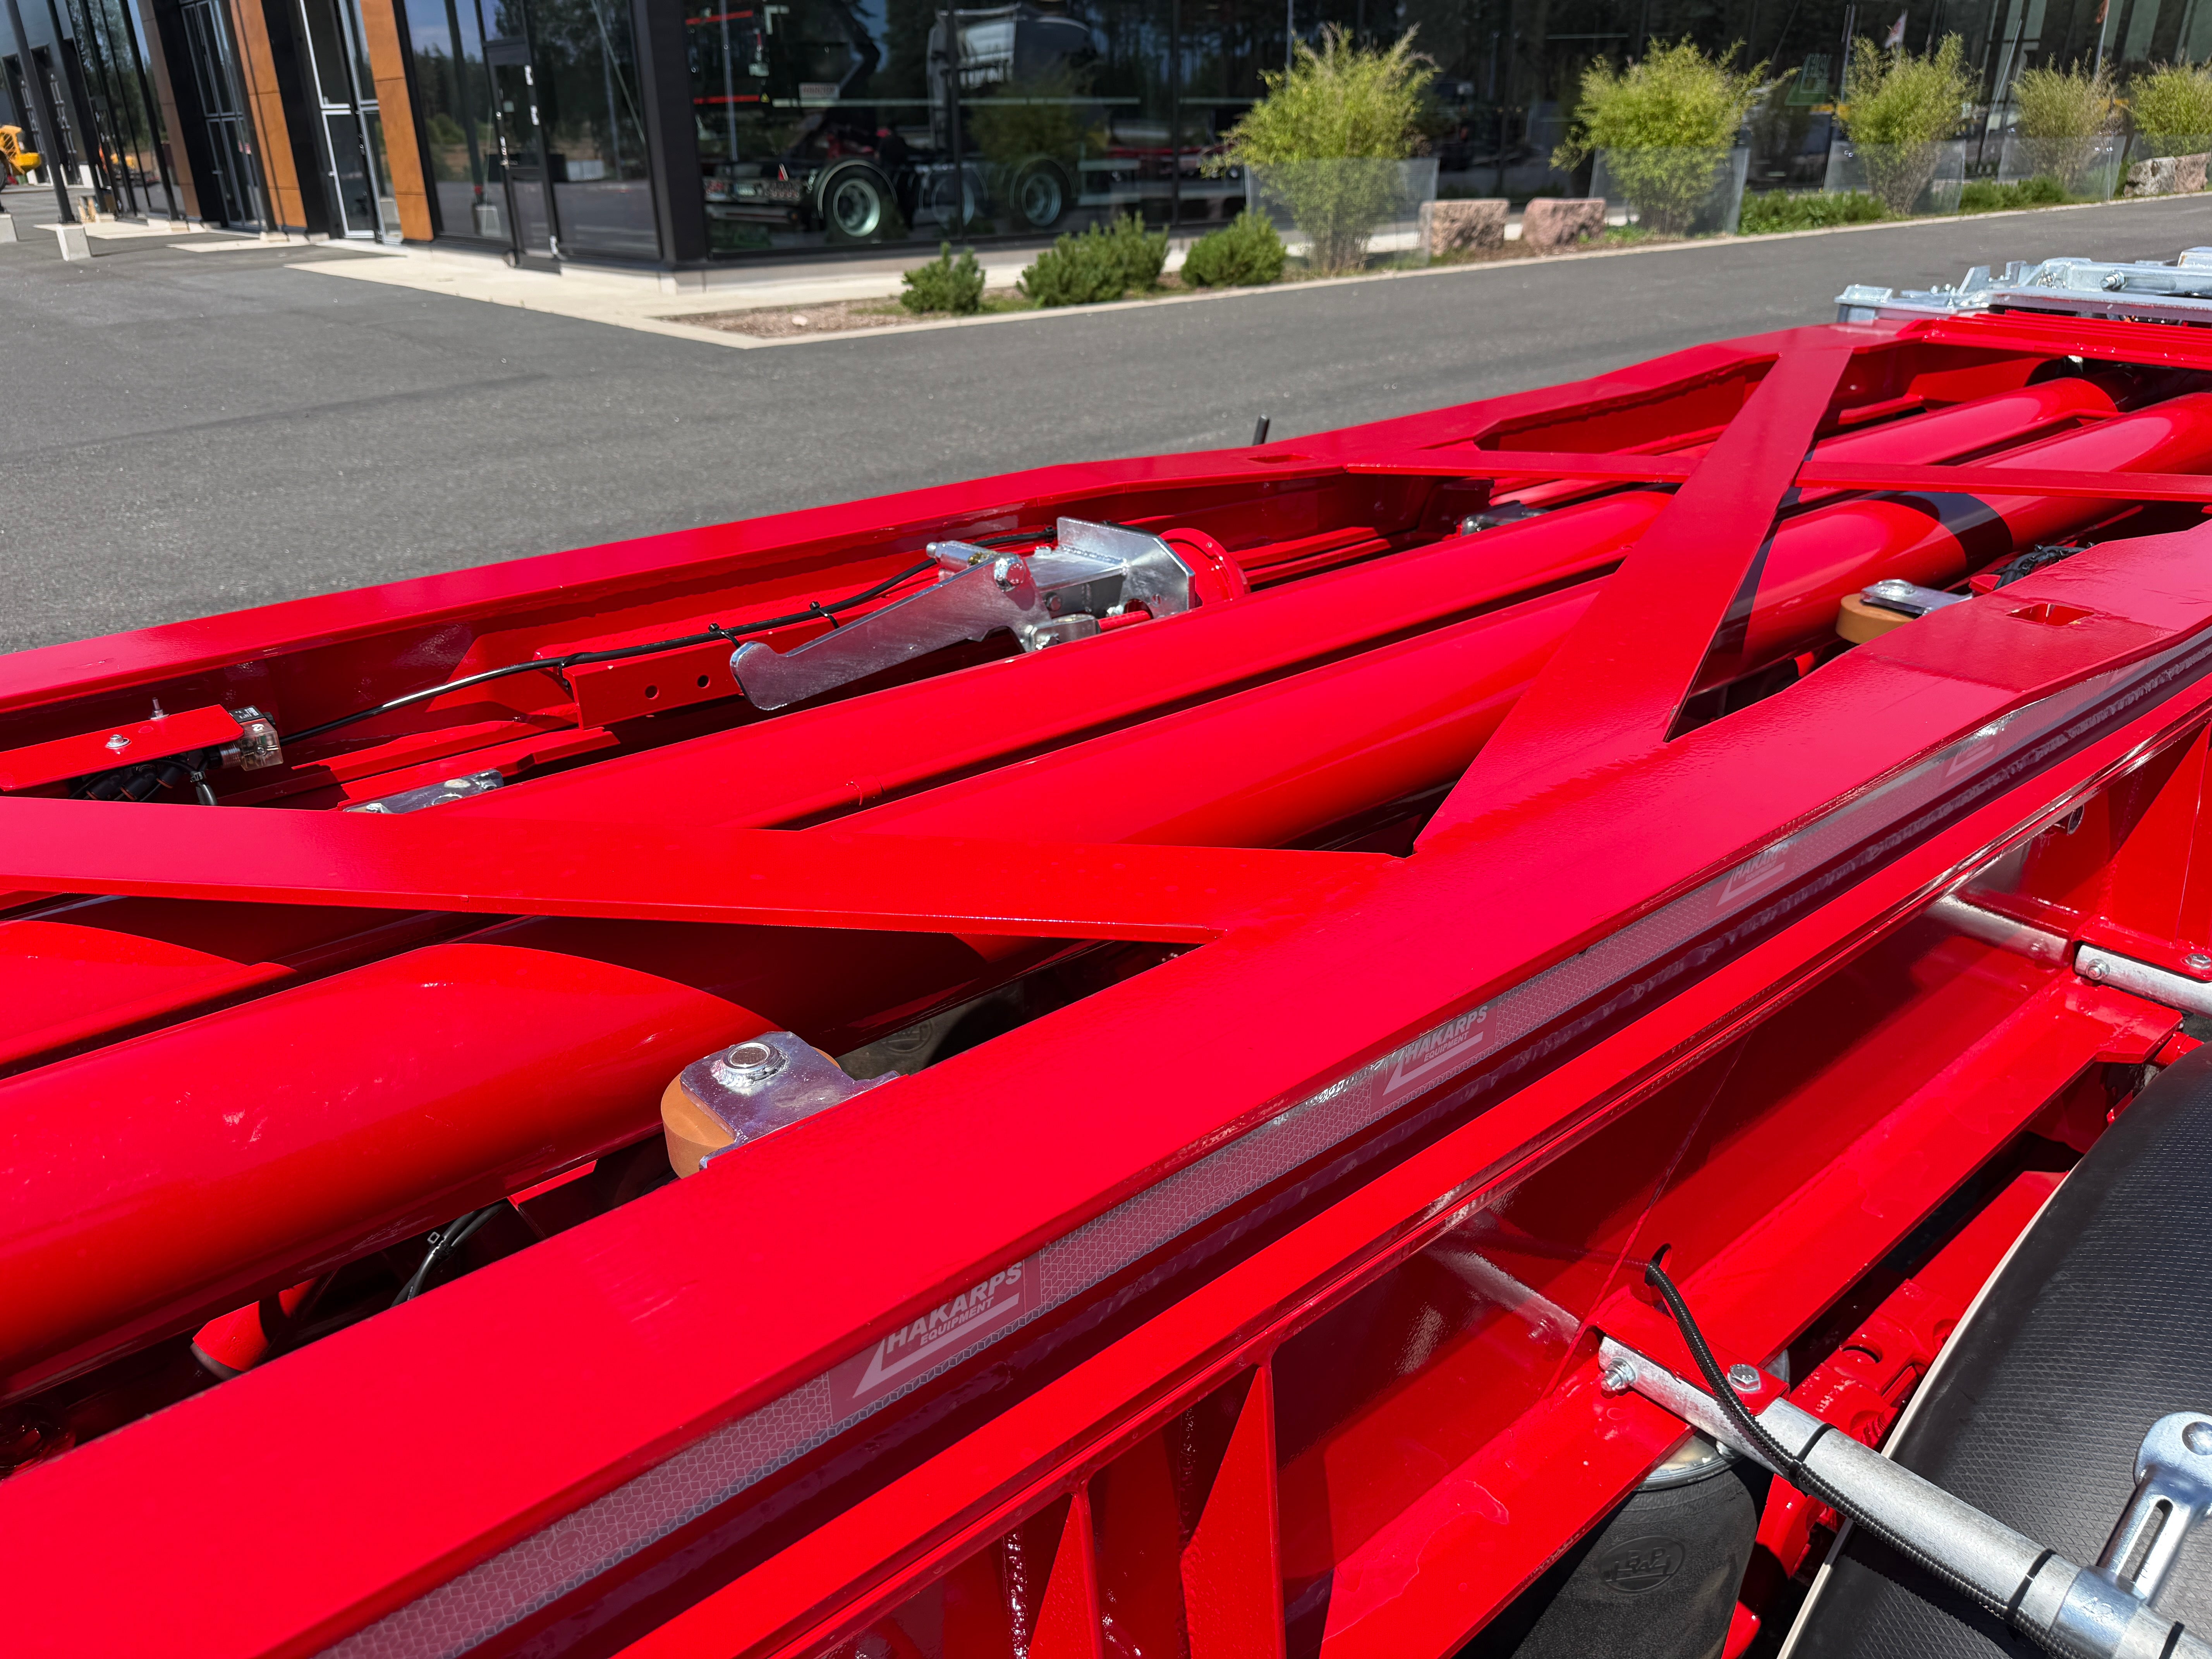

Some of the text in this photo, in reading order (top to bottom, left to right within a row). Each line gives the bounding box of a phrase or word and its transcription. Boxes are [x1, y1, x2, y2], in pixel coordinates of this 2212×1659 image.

[1405, 1005, 1488, 1064] HAKARPS
[1424, 1031, 1469, 1062] EQUIPMENT
[1214, 1169, 1227, 1183] E4
[1192, 1198, 1206, 1212] 104
[886, 1261, 1022, 1353] HAKARPS
[919, 1297, 995, 1345] EQUIPMENT
[524, 1577, 548, 1597] 104
